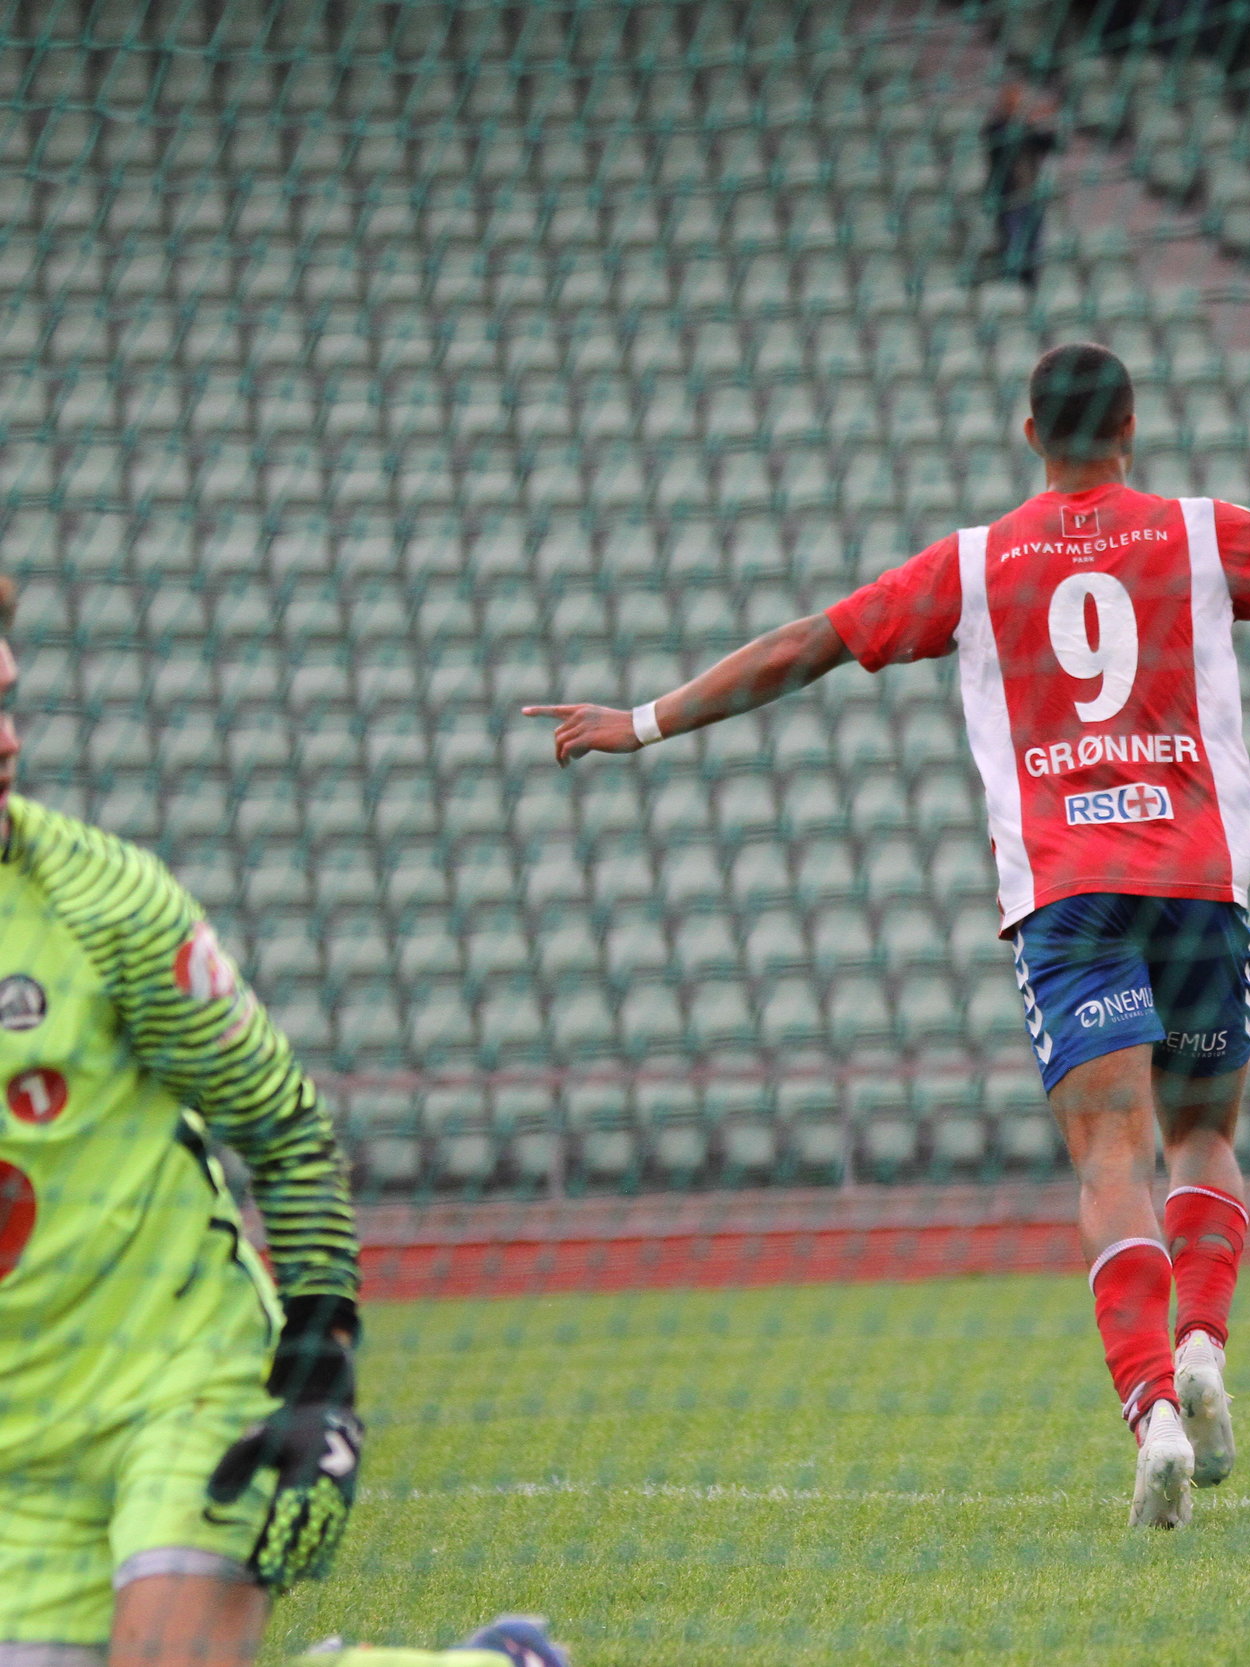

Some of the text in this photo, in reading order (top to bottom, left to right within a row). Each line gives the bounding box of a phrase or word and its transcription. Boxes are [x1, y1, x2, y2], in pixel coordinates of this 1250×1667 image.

[1074, 515, 1086, 529] P
[1000, 529, 1168, 563] PRIVATMEGLEREN
[1047, 571, 1139, 723] 9
[1025, 734, 1200, 777] GRØNNER
[1103, 987, 1153, 1016] NEMU
[1159, 1030, 1228, 1052] EMUS
[19, 1074, 50, 1116] 1
